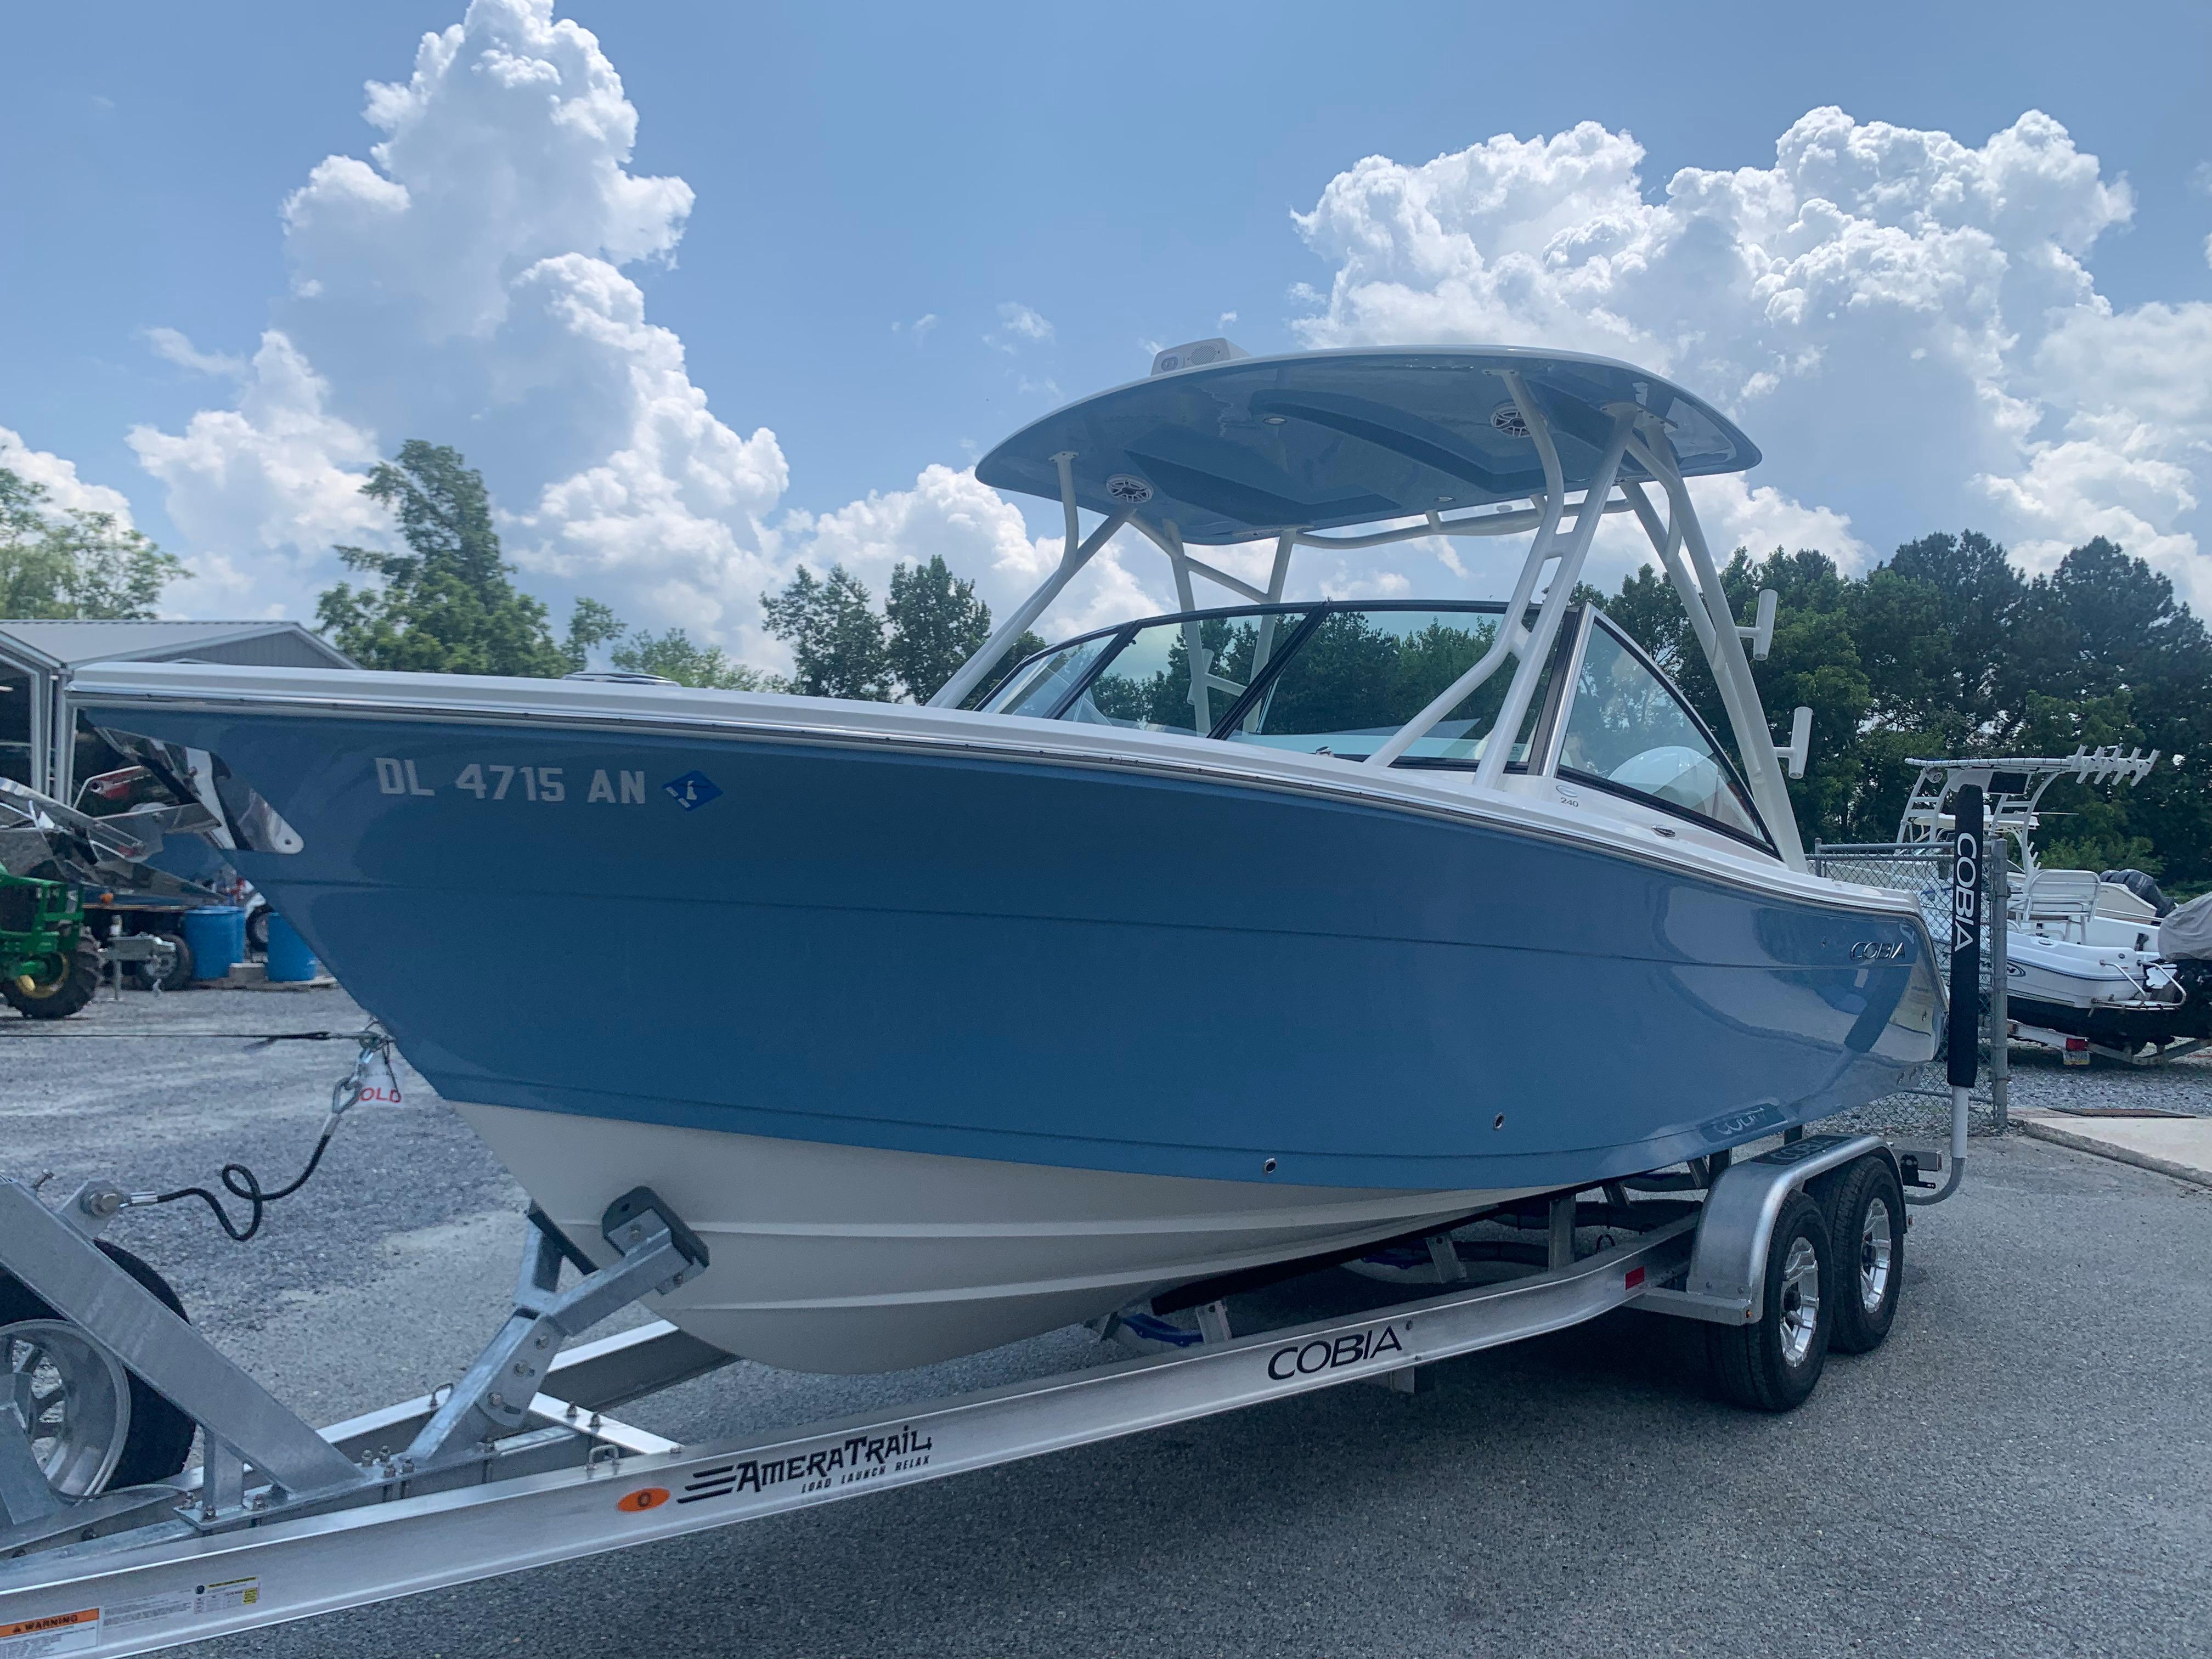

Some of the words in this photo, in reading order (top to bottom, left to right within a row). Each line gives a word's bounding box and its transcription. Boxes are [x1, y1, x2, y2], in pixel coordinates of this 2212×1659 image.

[375, 757, 435, 796] DL
[455, 764, 565, 802] 4715
[587, 769, 646, 804] AN
[1560, 797, 1579, 808] 240
[1954, 832, 1977, 952] COBIA
[1849, 941, 1906, 960] COBIA
[1267, 1325, 1402, 1380] COBIA
[802, 1478, 832, 1494] LOAD
[841, 1465, 887, 1485] LAUNCH
[895, 1455, 930, 1471] RELAX
